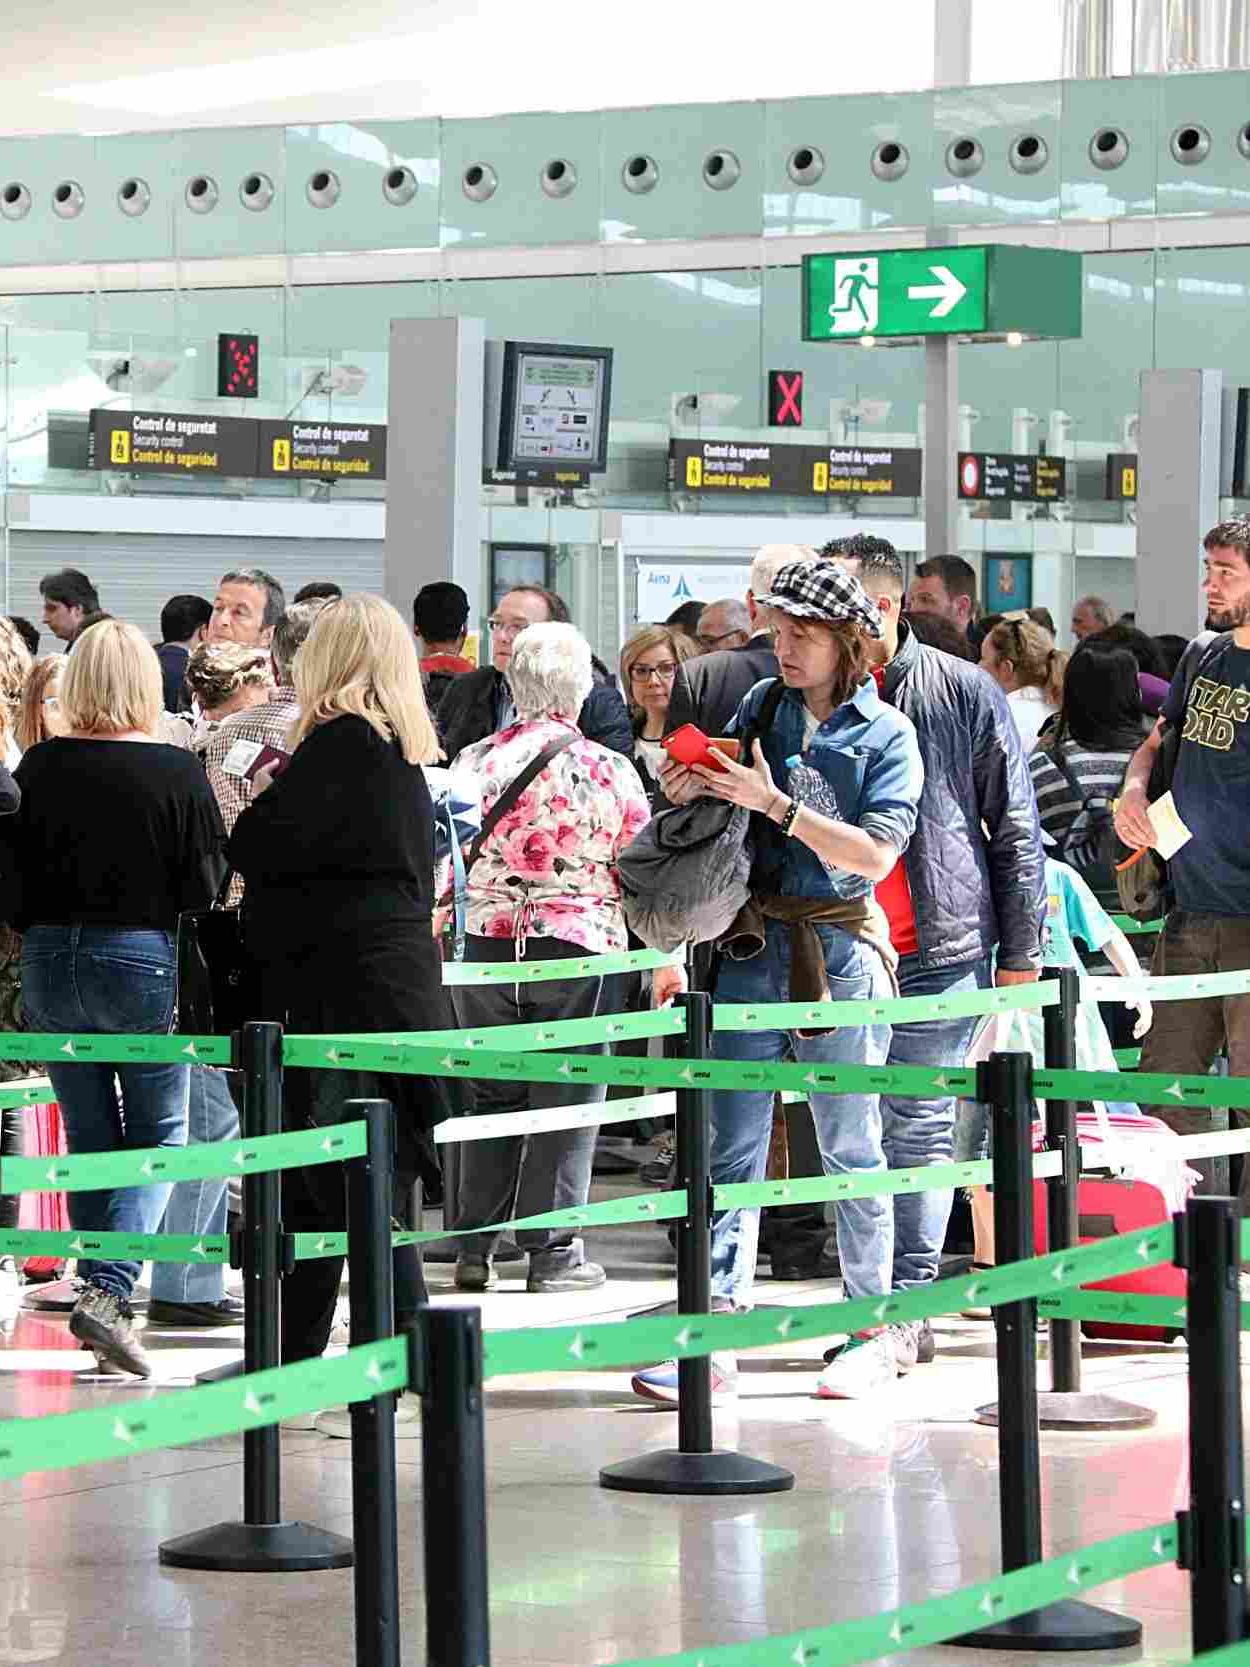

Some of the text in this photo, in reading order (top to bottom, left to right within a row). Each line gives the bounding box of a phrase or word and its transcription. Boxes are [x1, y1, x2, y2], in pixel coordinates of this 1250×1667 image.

[133, 416, 217, 436] Control de seguretat
[293, 425, 369, 443] Control de seguretat
[133, 433, 184, 448] Security control
[132, 448, 217, 468] Control de seguridad
[1188, 676, 1250, 723] TAR
